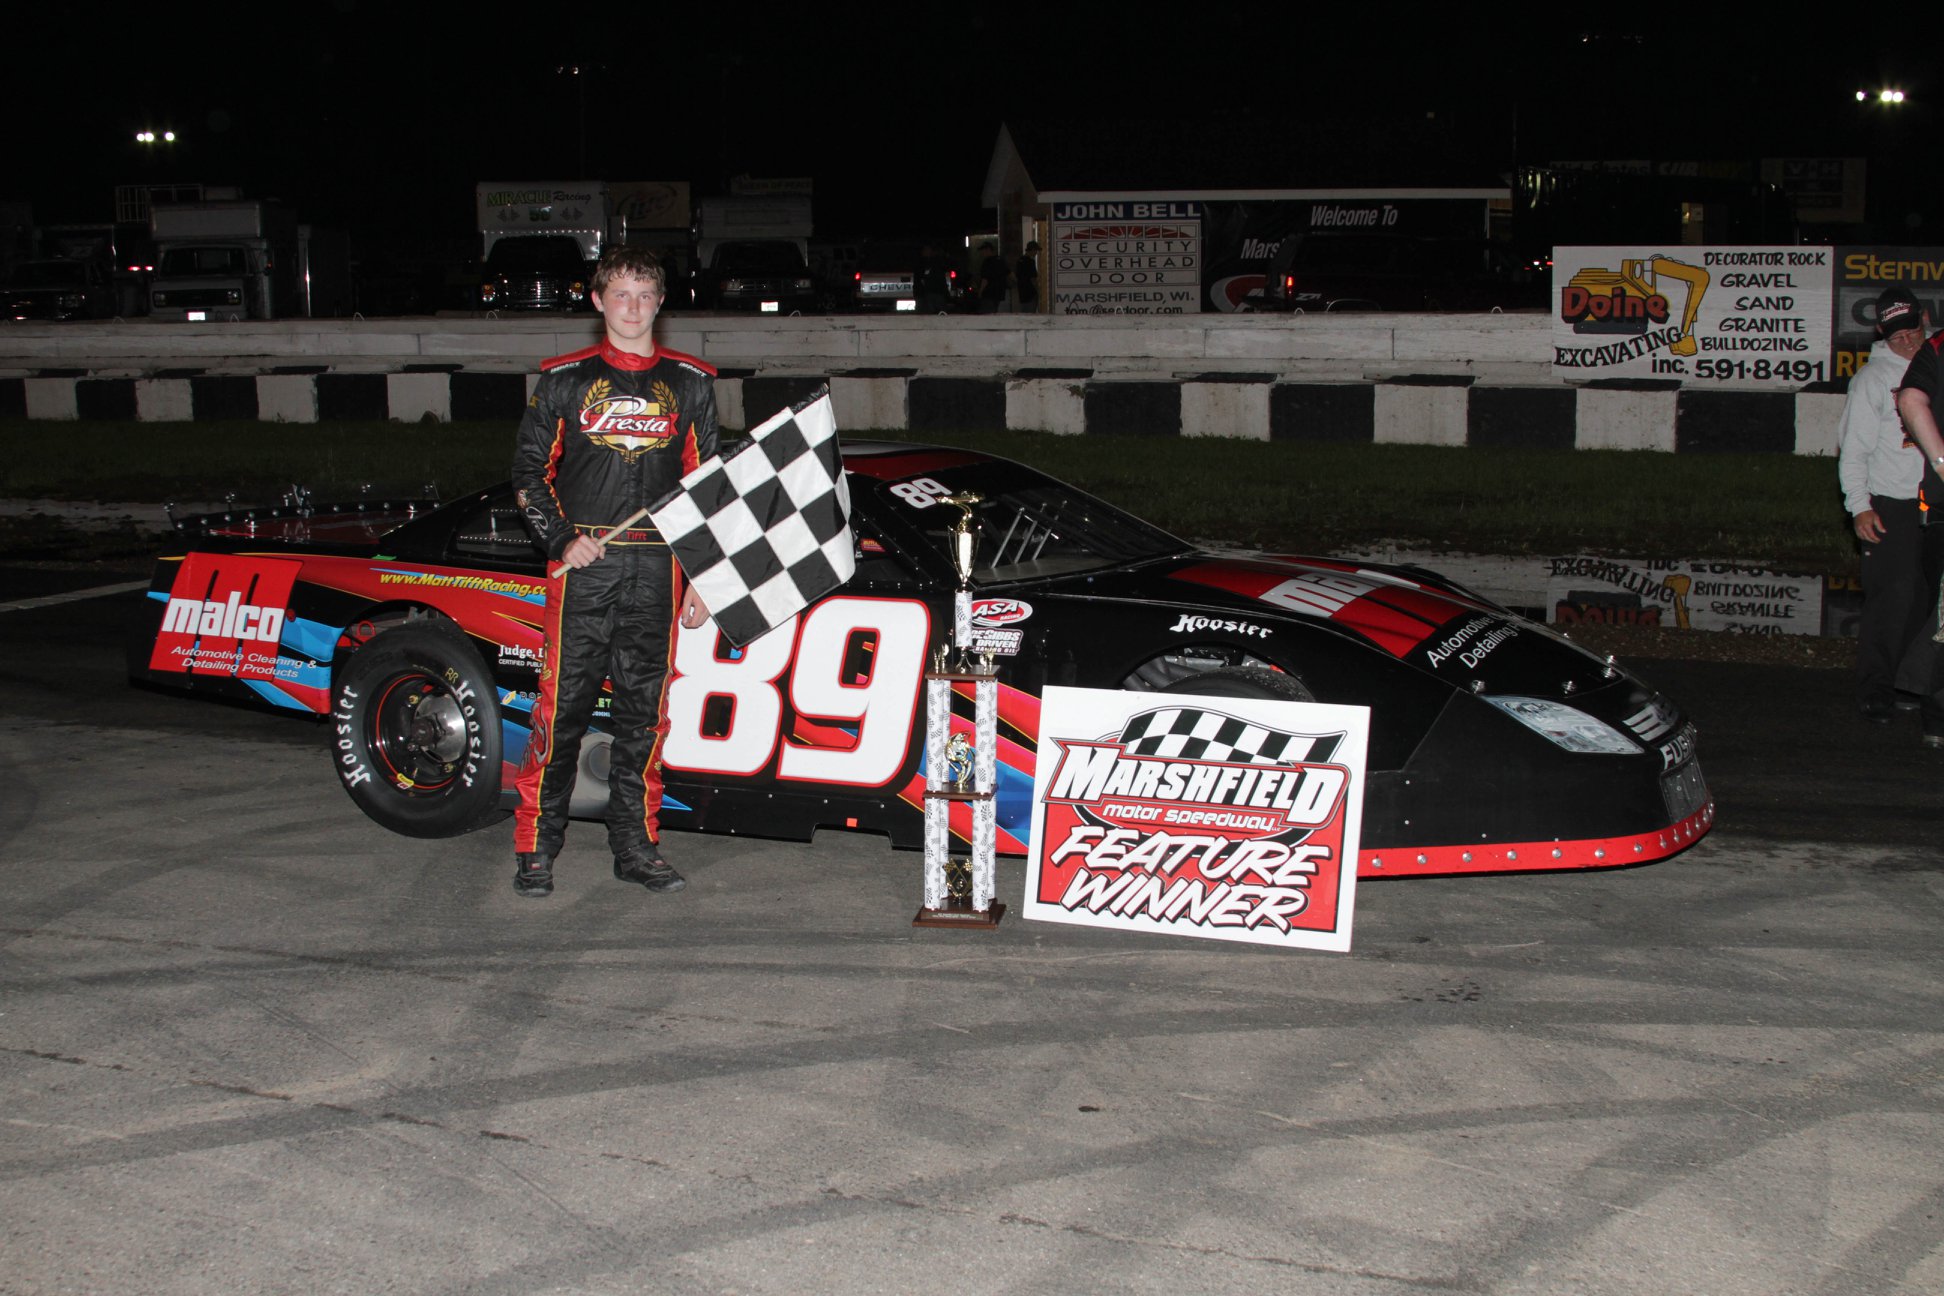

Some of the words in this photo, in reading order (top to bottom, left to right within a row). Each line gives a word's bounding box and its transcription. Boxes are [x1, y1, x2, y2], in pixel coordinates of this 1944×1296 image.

[487, 190, 552, 207] MIRACLE
[1056, 203, 1124, 219] JOHN
[1133, 203, 1201, 219] BELL
[1310, 204, 1378, 227] Welcome
[1380, 204, 1399, 227] To
[1062, 241, 1191, 254] SECURITY
[1240, 238, 1286, 260] Mars
[1059, 256, 1194, 269] OVERHEAD
[1703, 252, 1784, 267] DECORATOR
[1787, 251, 1826, 266] ROCK
[1089, 272, 1164, 284] DOOR
[1720, 273, 1798, 289] GRAVEL
[1056, 292, 1166, 304] MARSHFIELD,
[1561, 286, 1671, 324] Doine
[1734, 296, 1794, 312] SAND
[1718, 318, 1806, 333] GRANITE
[1553, 326, 1685, 369] EXCAVATING
[1700, 337, 1809, 352] BULLDOZING
[679, 361, 707, 377] IMPACT
[1651, 354, 1690, 374] inc.
[580, 396, 671, 434] Presta
[889, 477, 953, 509] 89
[161, 590, 285, 643] malco
[972, 602, 1019, 618] ASA
[1169, 614, 1273, 639] Hoosier
[498, 644, 536, 660] Judge,
[976, 640, 1018, 649] DRIVEN
[1427, 616, 1494, 669] Automotive
[1459, 627, 1518, 669] Detailing
[171, 646, 244, 661] Automotive
[247, 653, 304, 668] Cleaning
[306, 660, 317, 669] &
[182, 658, 239, 672] Detailing
[242, 664, 299, 678] Products
[444, 667, 459, 684] RR
[661, 595, 931, 787] 89
[333, 685, 371, 788] Hoosier
[451, 680, 487, 788] Hoosier
[1050, 744, 1346, 824] MARSHFIELD
[1102, 803, 1162, 821] motor
[1164, 807, 1276, 832] speedway
[1050, 825, 1331, 887] FEATURE
[1060, 867, 1309, 936] WINNER
